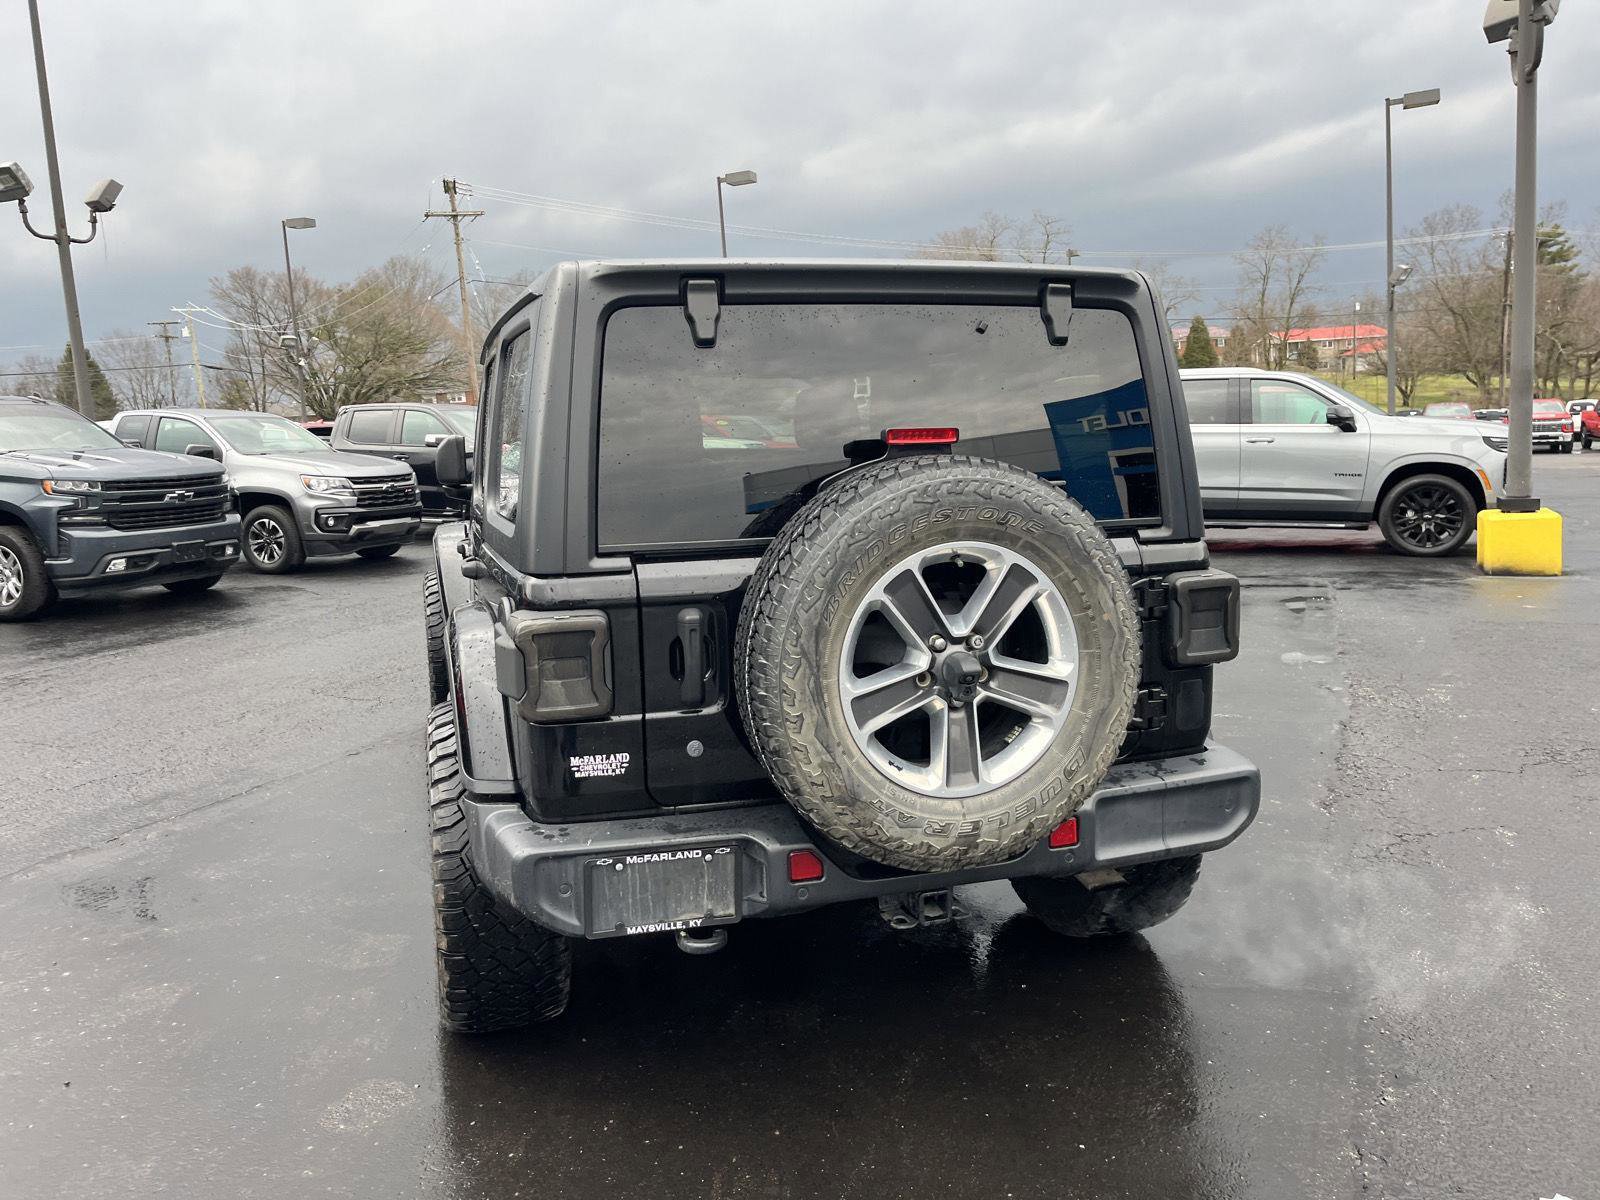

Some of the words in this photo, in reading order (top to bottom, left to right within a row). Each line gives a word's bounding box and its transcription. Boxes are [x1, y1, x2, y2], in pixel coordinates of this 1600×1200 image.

[822, 504, 1046, 627] BRIDGESTONE
[570, 752, 630, 767] McFARLAND
[579, 762, 622, 772] CHEVROLET
[574, 769, 616, 778] MAYSVILLE,
[616, 767, 626, 775] KY
[922, 745, 1087, 838] DUELER
[625, 849, 702, 865] McFARLAND
[626, 920, 686, 935] MAYSVILLE,
[689, 918, 703, 928] KY
